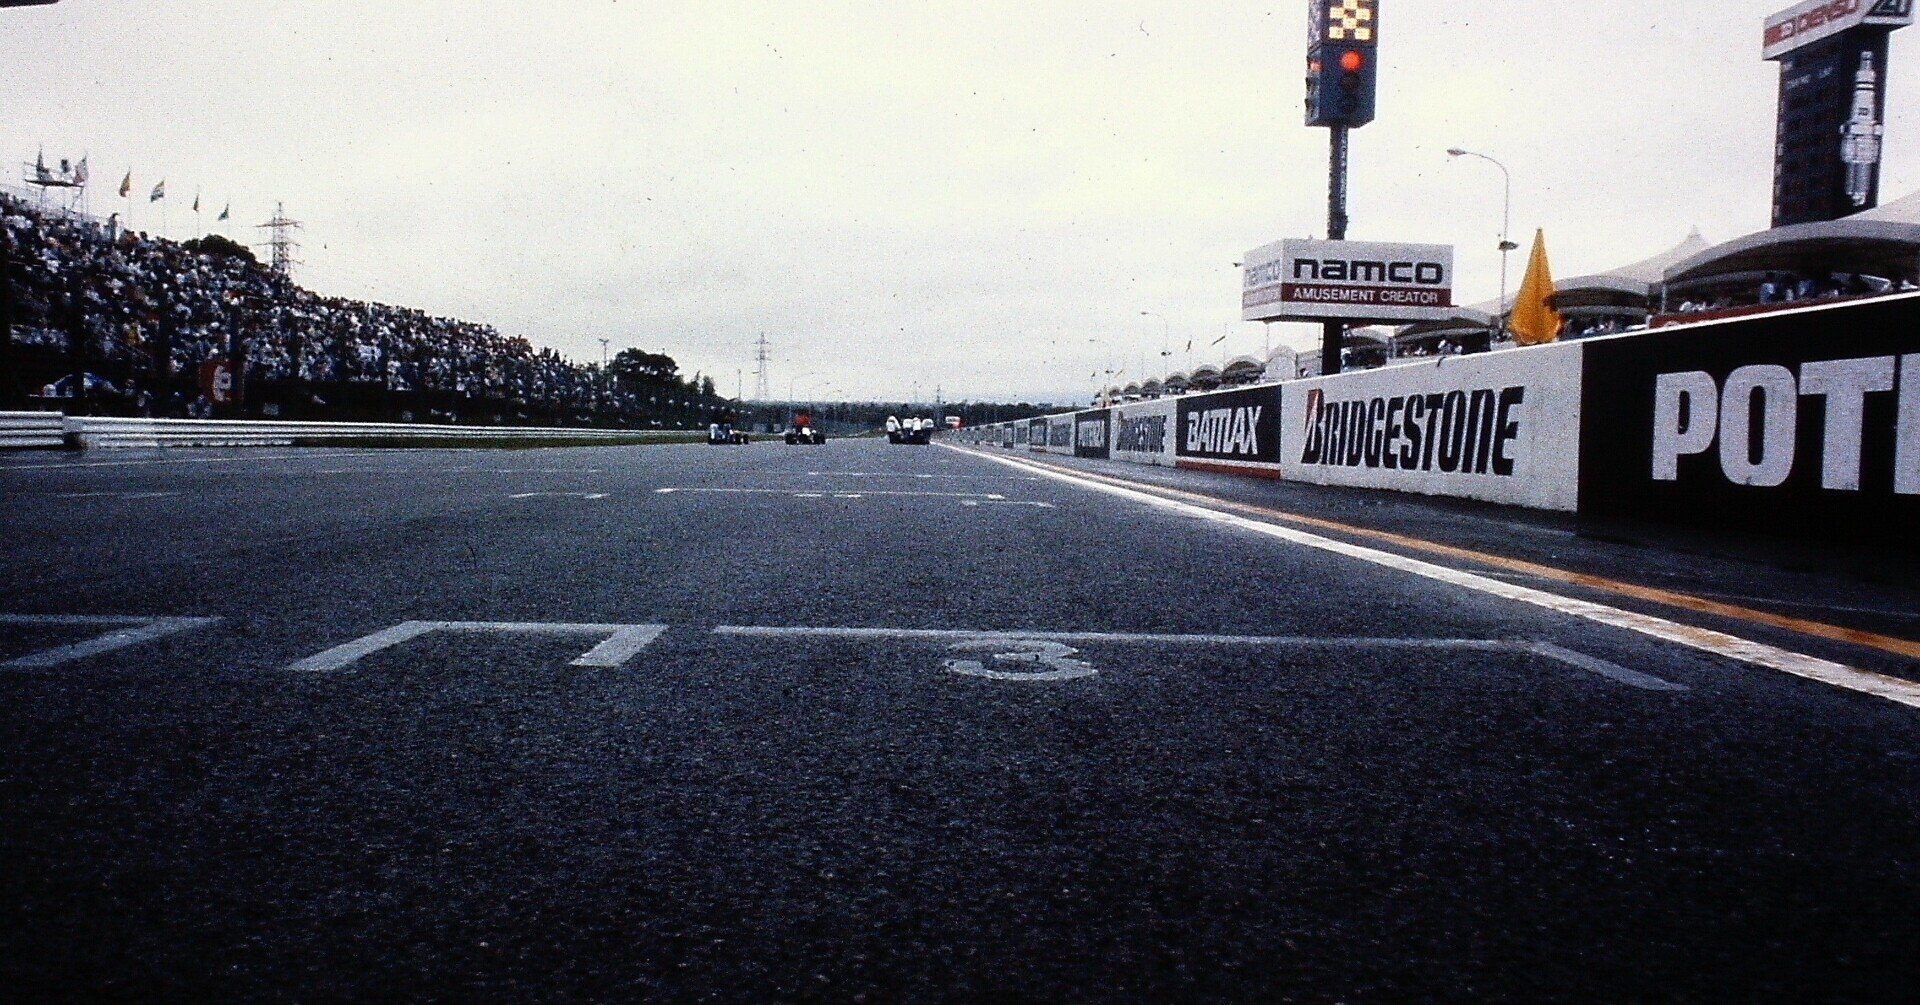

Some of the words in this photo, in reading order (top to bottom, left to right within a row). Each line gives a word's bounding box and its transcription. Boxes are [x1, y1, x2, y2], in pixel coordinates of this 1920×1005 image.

[1294, 258, 1443, 284] namco
[1293, 288, 1375, 302] AMUSEMENT
[1381, 289, 1438, 304] CREATOR
[1301, 387, 1524, 475] BRIDGESTONE
[1652, 352, 1920, 495] POT
[942, 639, 1098, 681] 3
